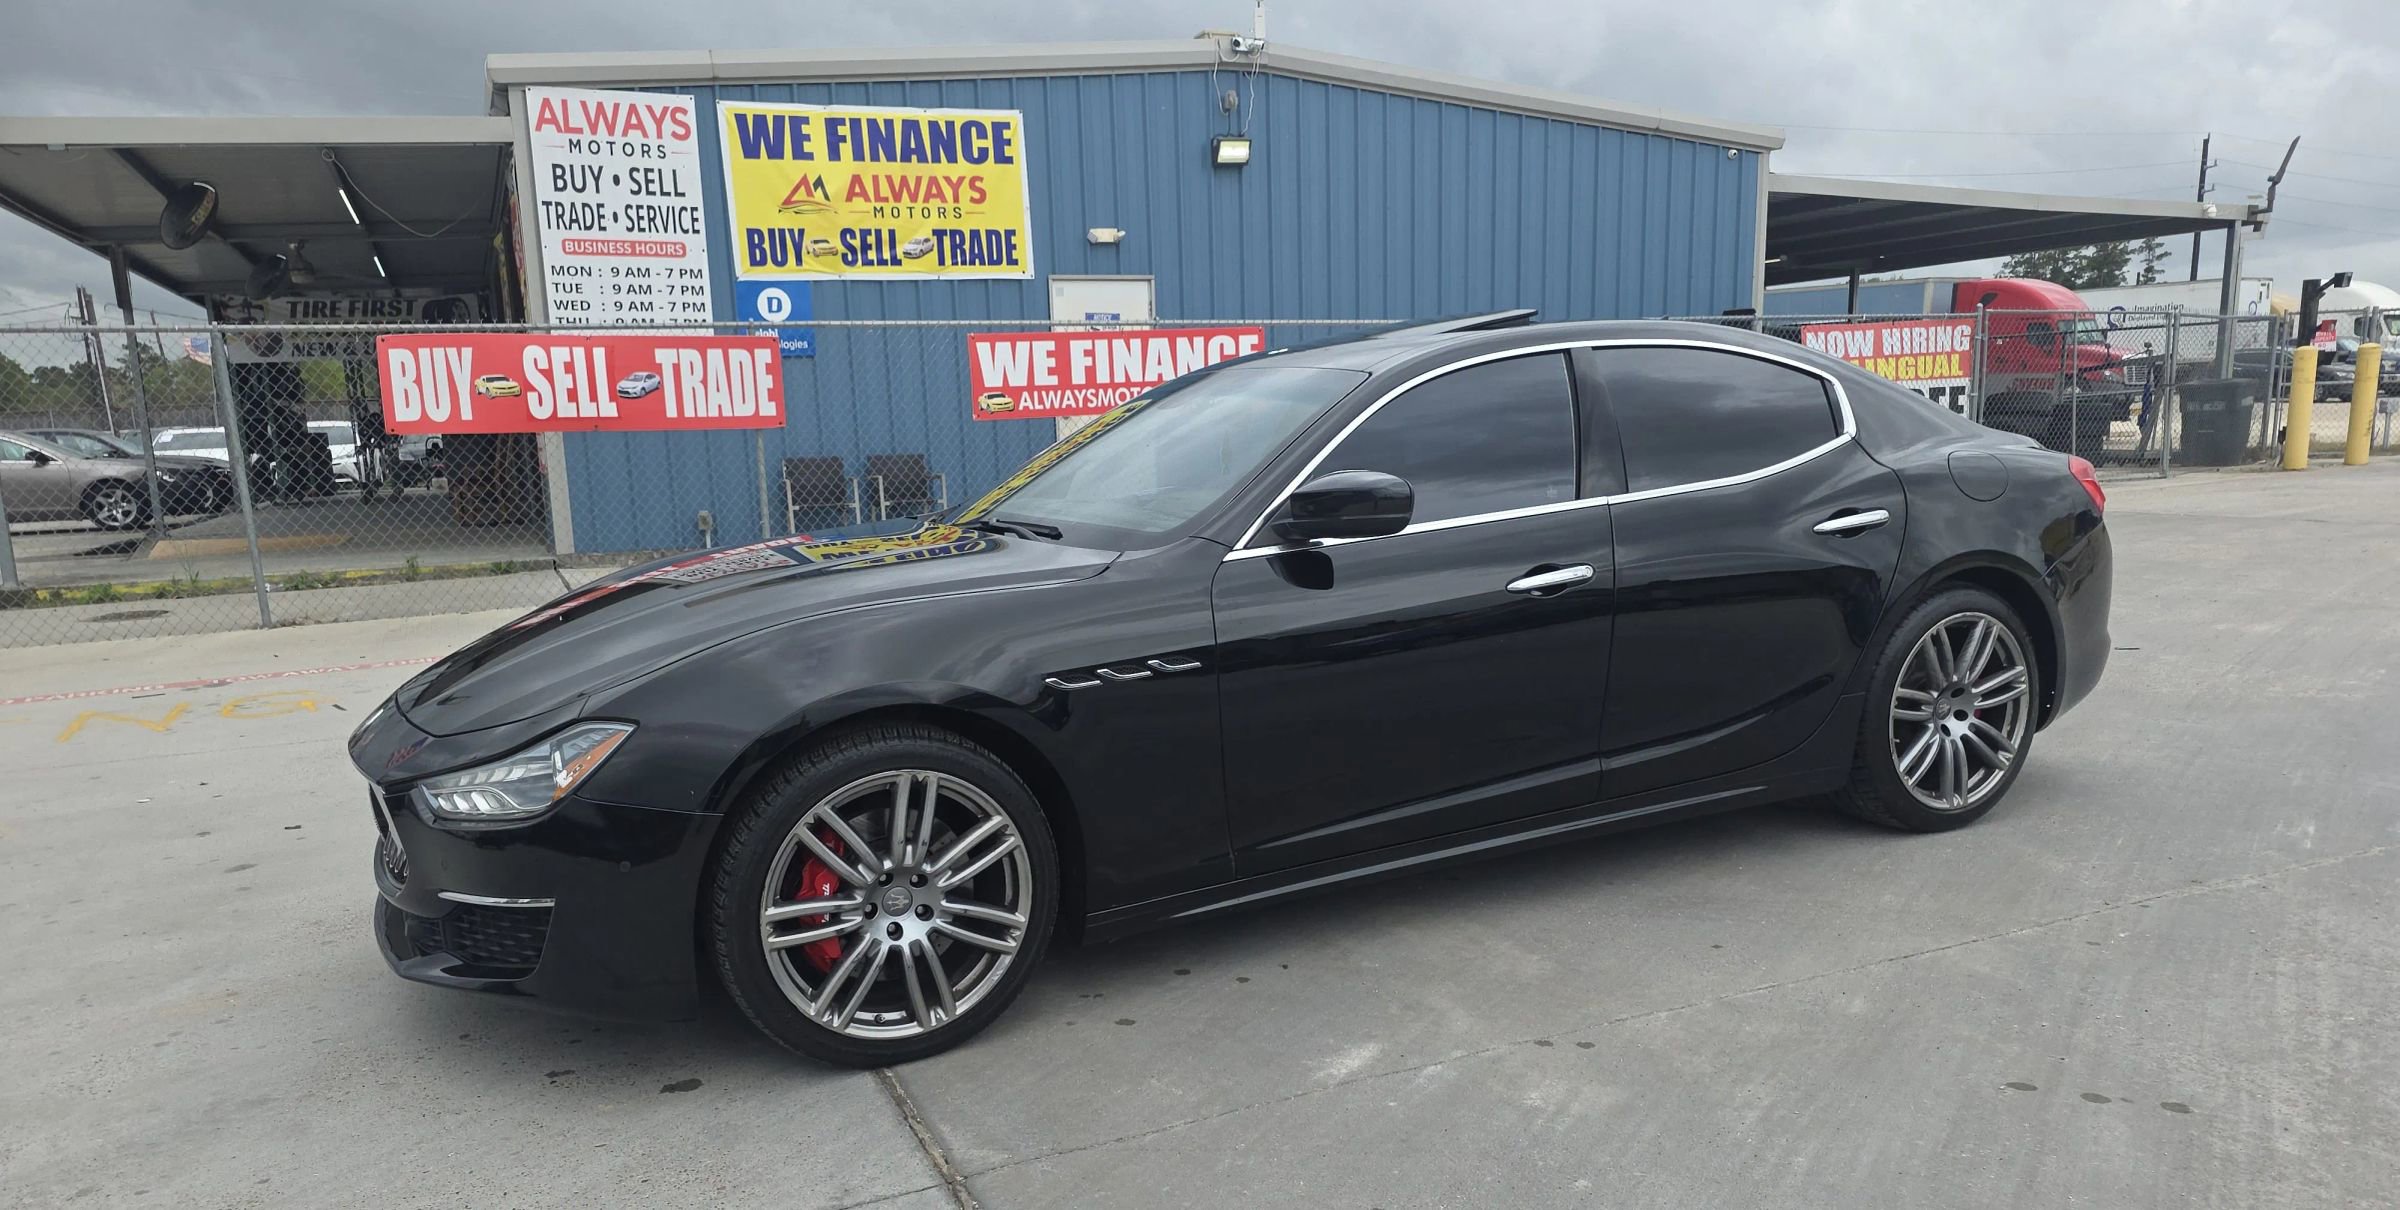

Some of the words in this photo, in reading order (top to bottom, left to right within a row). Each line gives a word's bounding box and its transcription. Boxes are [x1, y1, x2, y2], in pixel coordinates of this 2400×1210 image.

[535, 97, 692, 141] ALWAYS
[568, 138, 667, 159] MOTORS
[734, 113, 815, 161] WE
[824, 116, 1015, 165] FINANCE
[551, 163, 604, 194] BUY
[628, 166, 686, 198] SELL
[845, 174, 988, 205] ALWAYS
[541, 200, 608, 232] TRADE
[624, 203, 701, 234] SERVICE
[873, 206, 964, 220] MOTORS
[564, 240, 632, 254] BUSINESS
[635, 242, 684, 256] HOURS
[746, 228, 806, 267] BUY
[839, 228, 903, 267] SELL
[932, 228, 1020, 267] TRADE
[551, 265, 592, 277] MON
[610, 266, 620, 278] 9
[625, 267, 651, 278] AM
[665, 268, 674, 279] 7
[679, 268, 703, 279] PM
[552, 282, 583, 294] TUE
[612, 284, 621, 295] 9
[626, 284, 652, 295] AM
[666, 285, 675, 296] 7
[681, 285, 705, 296] PM
[286, 299, 342, 319] TIRE
[348, 299, 419, 318] FIRST
[554, 299, 591, 311] WED
[614, 301, 623, 312] 9
[628, 301, 654, 312] AM
[668, 302, 677, 313] 7
[682, 302, 706, 313] PM
[1805, 329, 1874, 358] NOW
[1881, 325, 1972, 356] HIRING
[976, 340, 1059, 388] WE
[388, 347, 473, 423] BUY
[522, 345, 619, 420] SELL
[654, 348, 777, 418] TRADE
